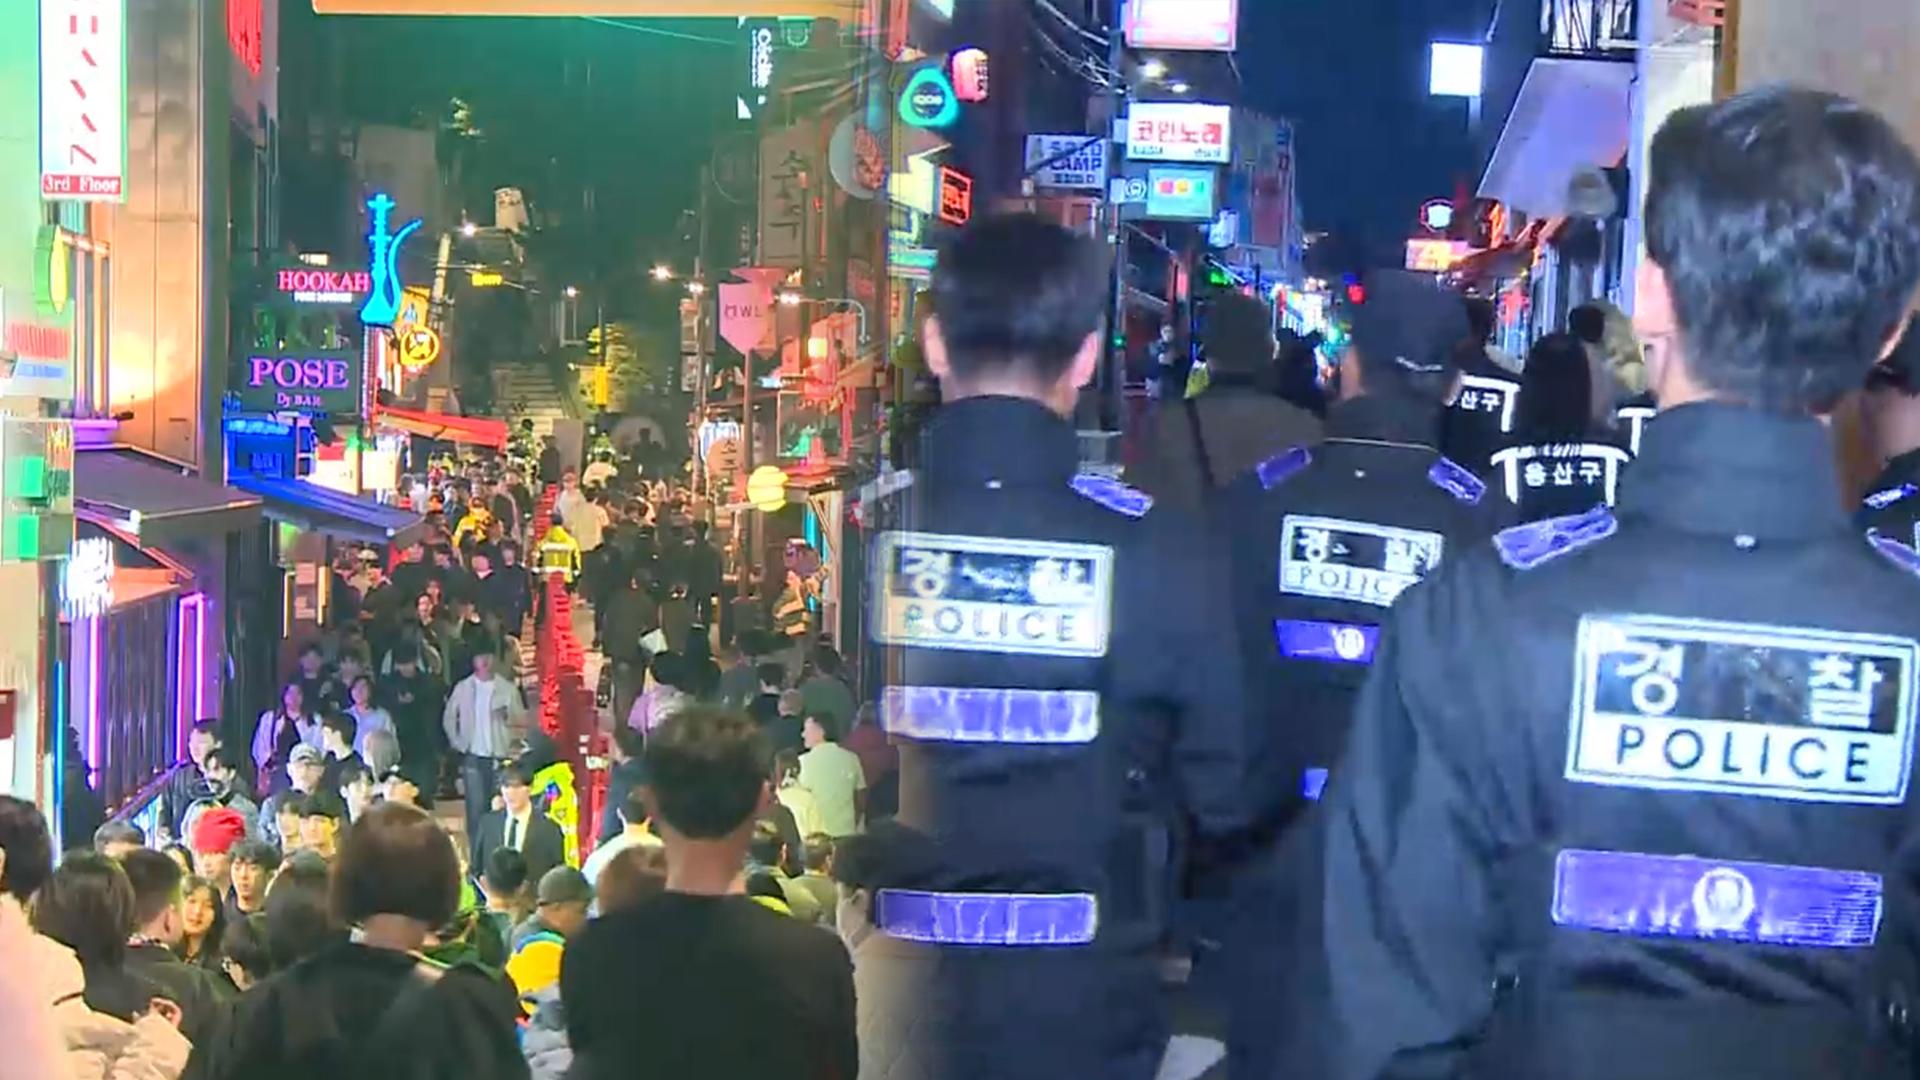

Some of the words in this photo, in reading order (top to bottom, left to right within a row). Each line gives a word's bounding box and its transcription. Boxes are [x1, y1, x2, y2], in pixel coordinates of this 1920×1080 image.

[45, 175, 70, 192] 3rd
[79, 176, 119, 193] Floor
[279, 270, 370, 292] HOOKAH
[249, 357, 350, 389] POSE
[1460, 390, 1500, 412] 산구
[1300, 564, 1394, 596] POLIC
[903, 604, 1077, 643] POLICE
[1616, 722, 1871, 783] POLICE
